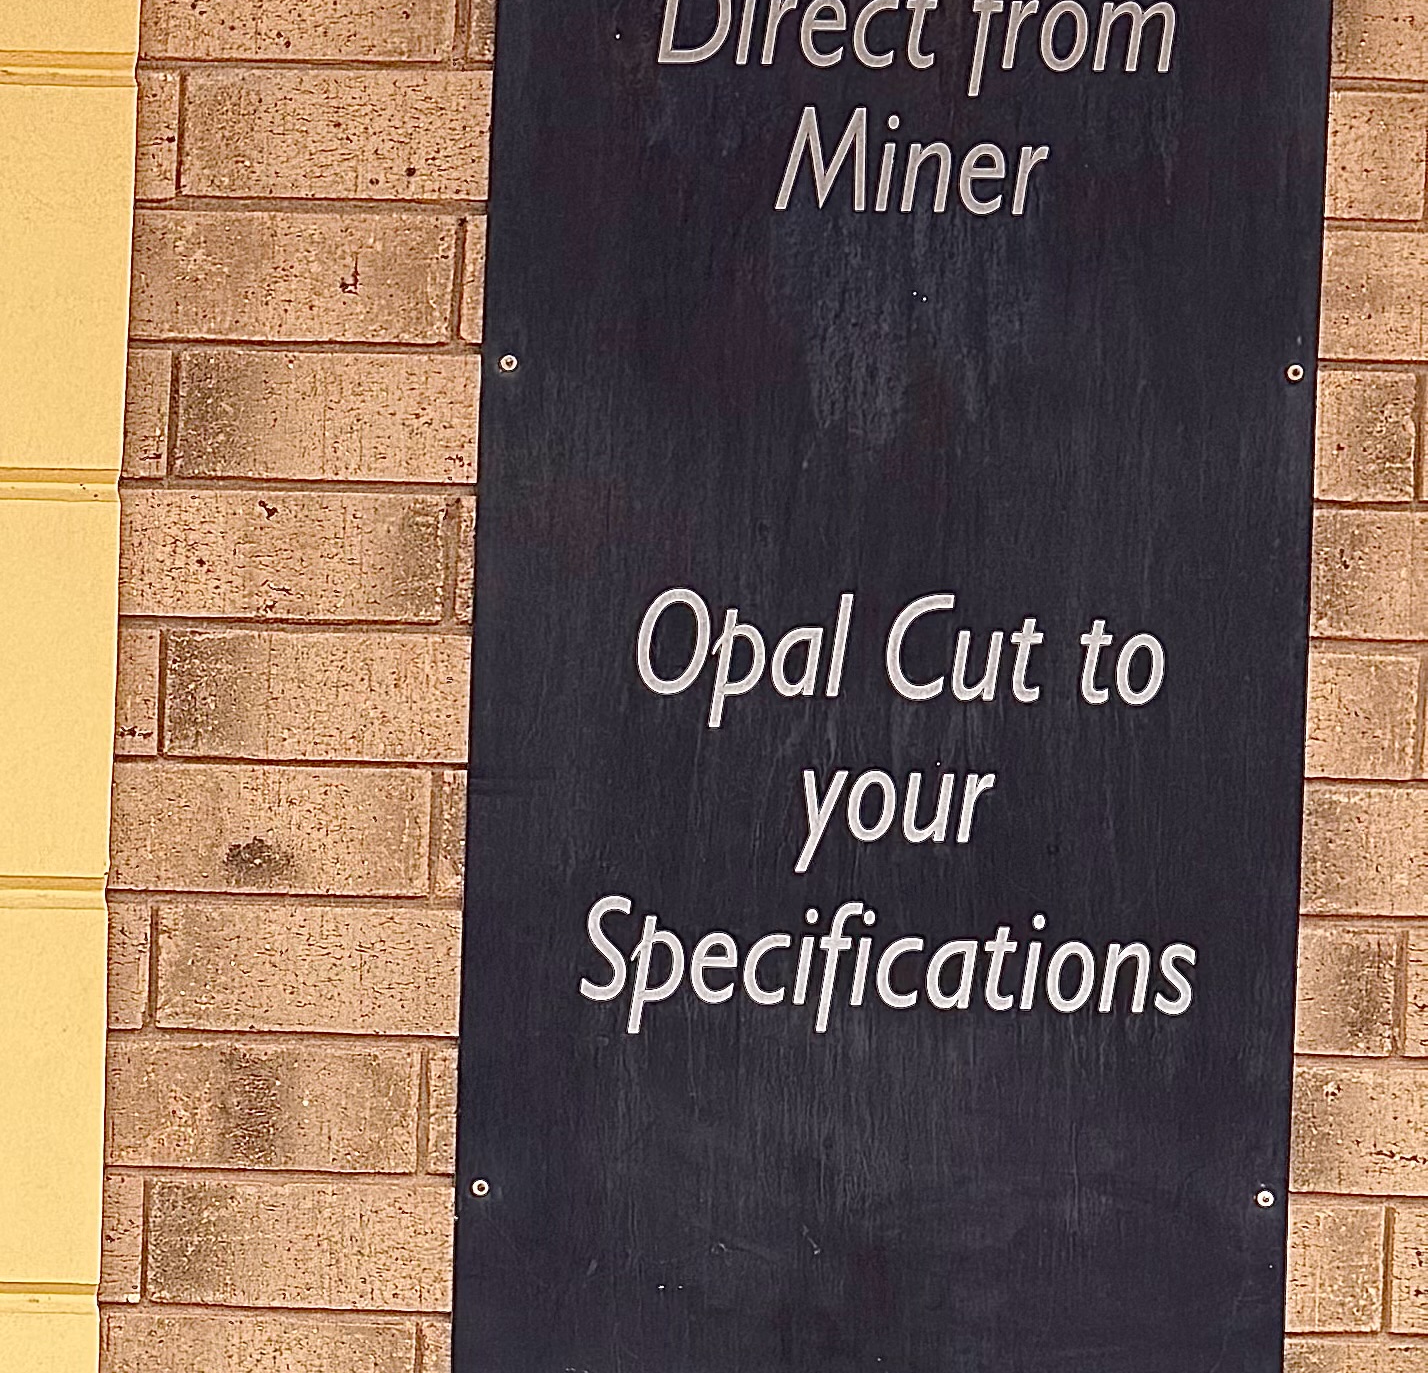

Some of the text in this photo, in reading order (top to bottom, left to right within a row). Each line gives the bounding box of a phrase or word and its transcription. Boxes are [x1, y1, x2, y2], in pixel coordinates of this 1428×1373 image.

[774, 106, 1050, 217] Miner
[636, 588, 1166, 729] Opal Cut to
[794, 768, 996, 873] your
[579, 895, 1198, 1034] Specifications
